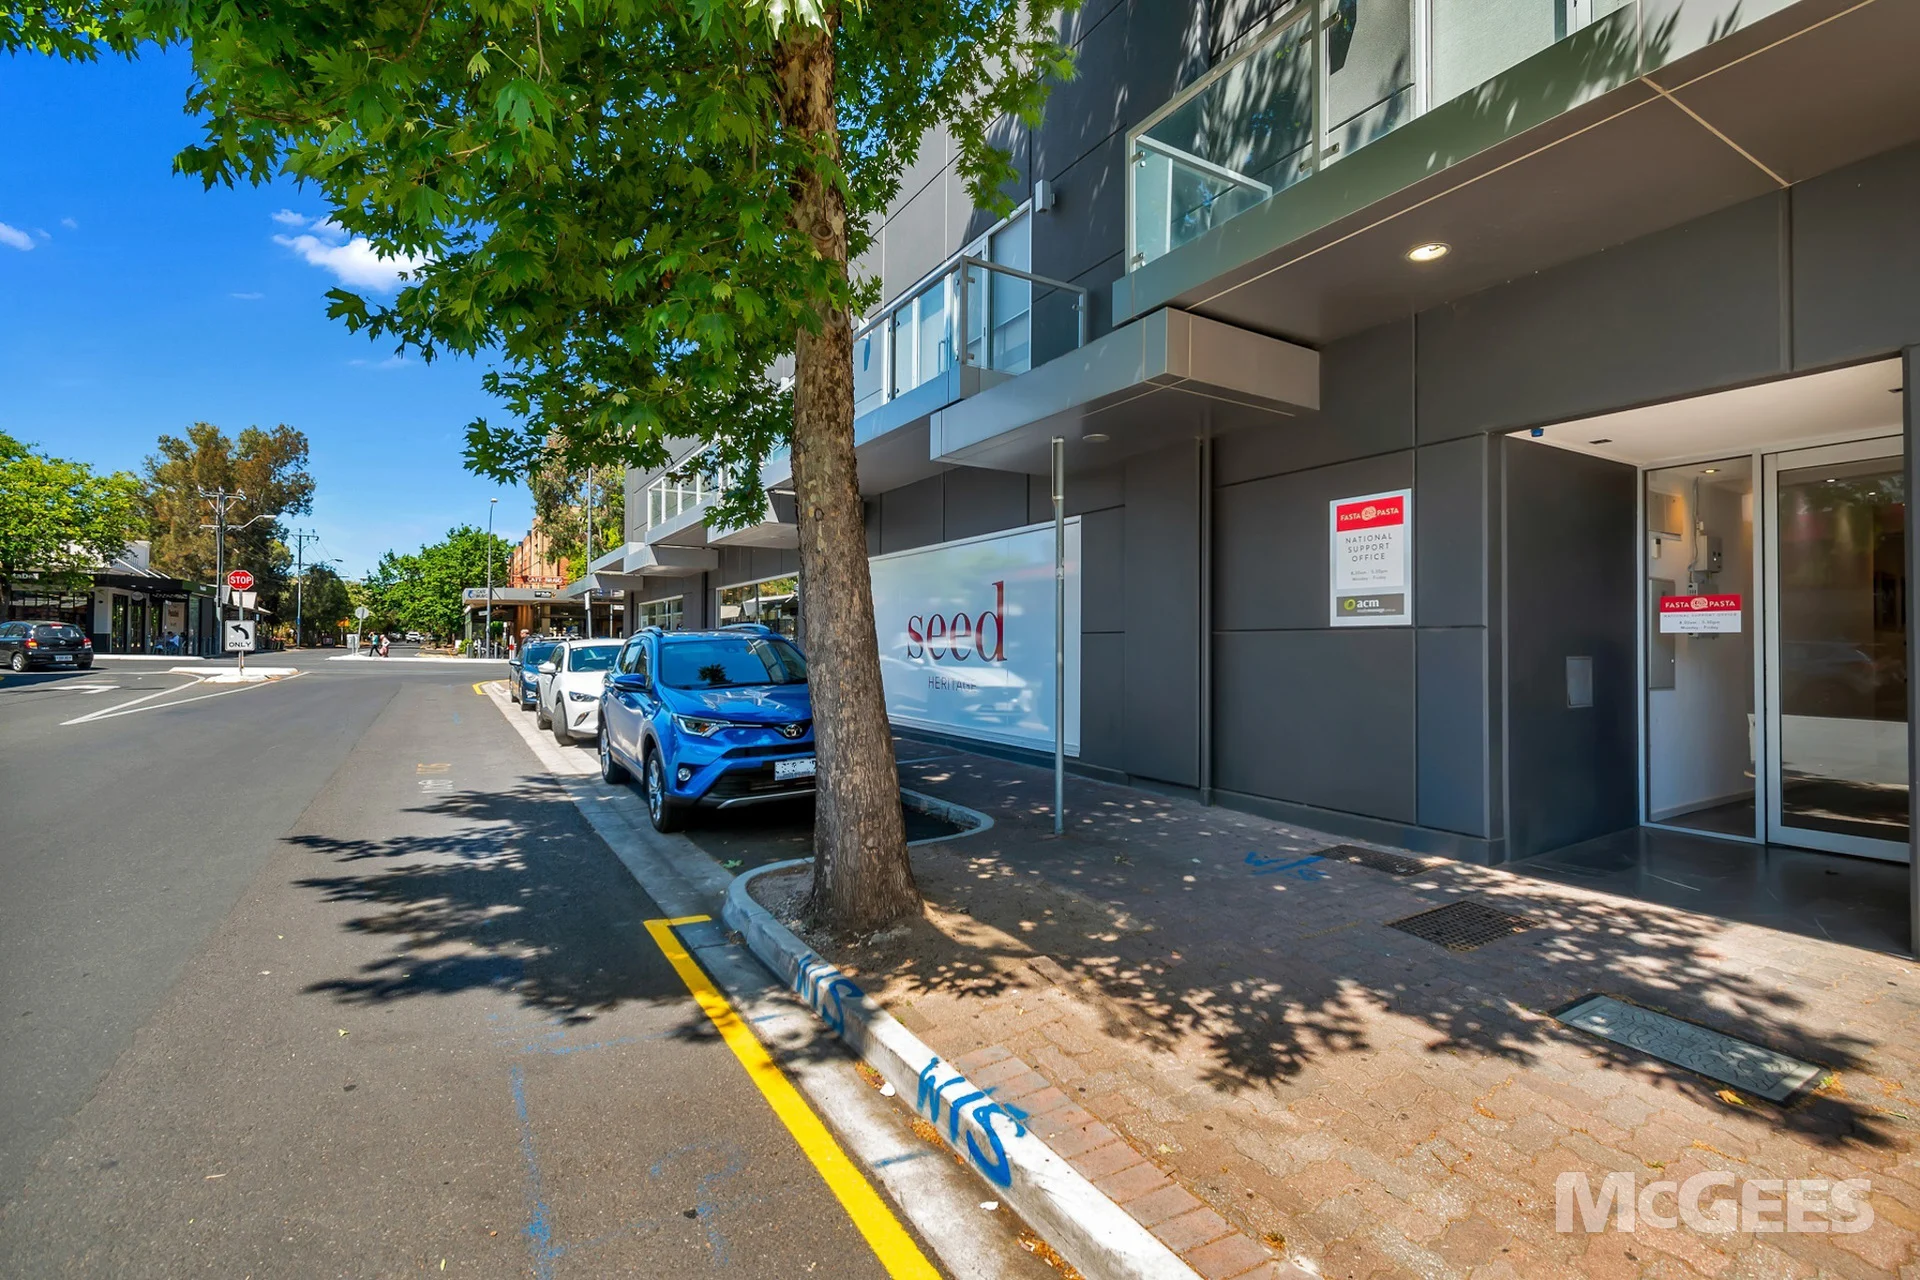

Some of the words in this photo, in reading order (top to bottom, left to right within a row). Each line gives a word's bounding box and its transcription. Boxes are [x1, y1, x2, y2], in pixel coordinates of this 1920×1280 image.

[1340, 512, 1361, 521] FASTA
[1376, 507, 1399, 516] PASTA
[1345, 533, 1392, 544] NATIONAL
[1347, 542, 1390, 554] SUPPORT
[1351, 552, 1385, 563] OFFICE
[230, 576, 252, 585] STOP
[1356, 599, 1379, 608] acm
[1665, 601, 1690, 609] FASTA
[1709, 600, 1736, 608] PASTA
[906, 580, 1008, 662] seed
